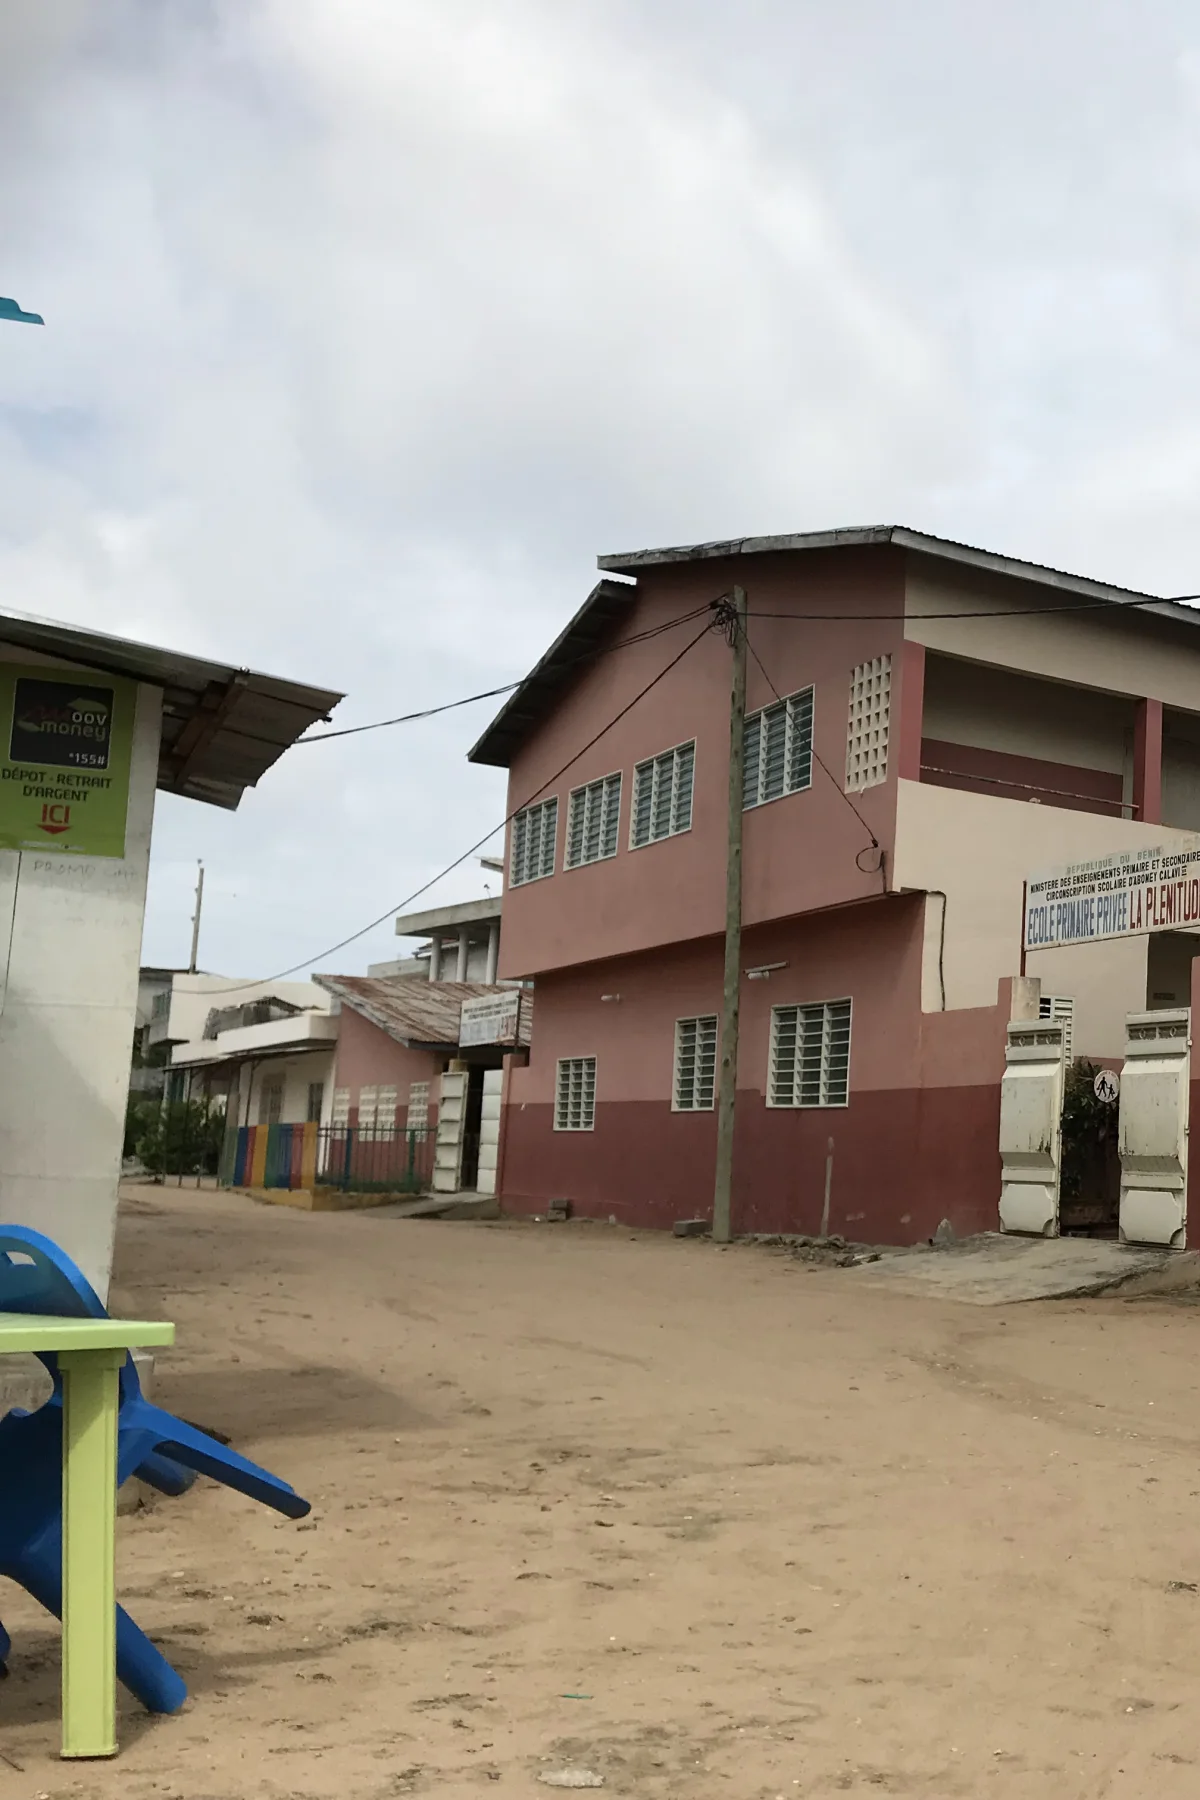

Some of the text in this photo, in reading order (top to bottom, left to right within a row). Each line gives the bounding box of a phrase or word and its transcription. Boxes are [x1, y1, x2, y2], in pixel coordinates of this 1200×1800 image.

[40, 720, 107, 742] money
[1, 767, 47, 784] DÉPOT
[56, 773, 114, 789] RETRAIT
[22, 785, 90, 801] D'ARGENT
[41, 803, 71, 824] ICI
[1120, 854, 1130, 865] DU
[1030, 851, 1200, 894] MINISTERE DES ENSEIGNEMENTS PRIMAIRE ET SECONDAIRE
[1046, 884, 1096, 901] CIRCONSCRIPTION
[1097, 877, 1127, 892] SCOLAIRE
[1160, 867, 1180, 881] CALAVI
[1027, 904, 1055, 945] ECOLE
[1056, 898, 1095, 941] PRIMAIRE
[1096, 892, 1127, 935] PRIVEE
[1129, 889, 1142, 930] LA
